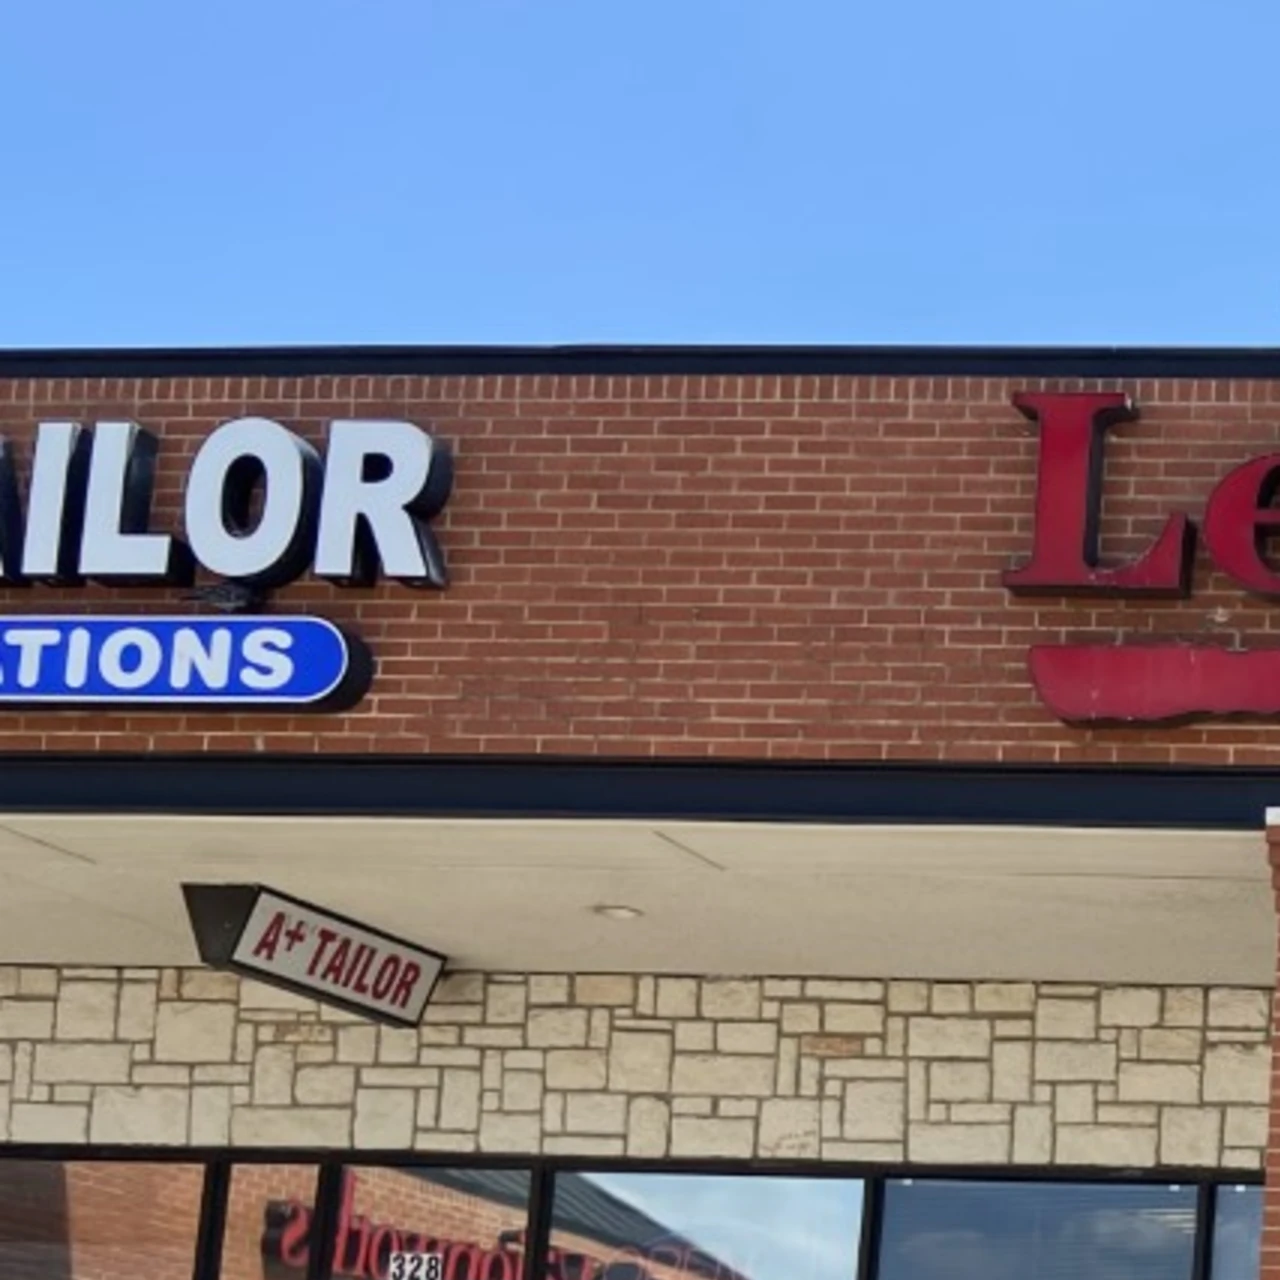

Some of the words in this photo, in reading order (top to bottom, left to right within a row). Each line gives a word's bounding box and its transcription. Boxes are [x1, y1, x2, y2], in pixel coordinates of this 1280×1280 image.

[0, 416, 452, 586] ILOR
[0, 627, 295, 690] TIONS
[253, 911, 306, 961] A+
[307, 927, 421, 1009] TAILOR
